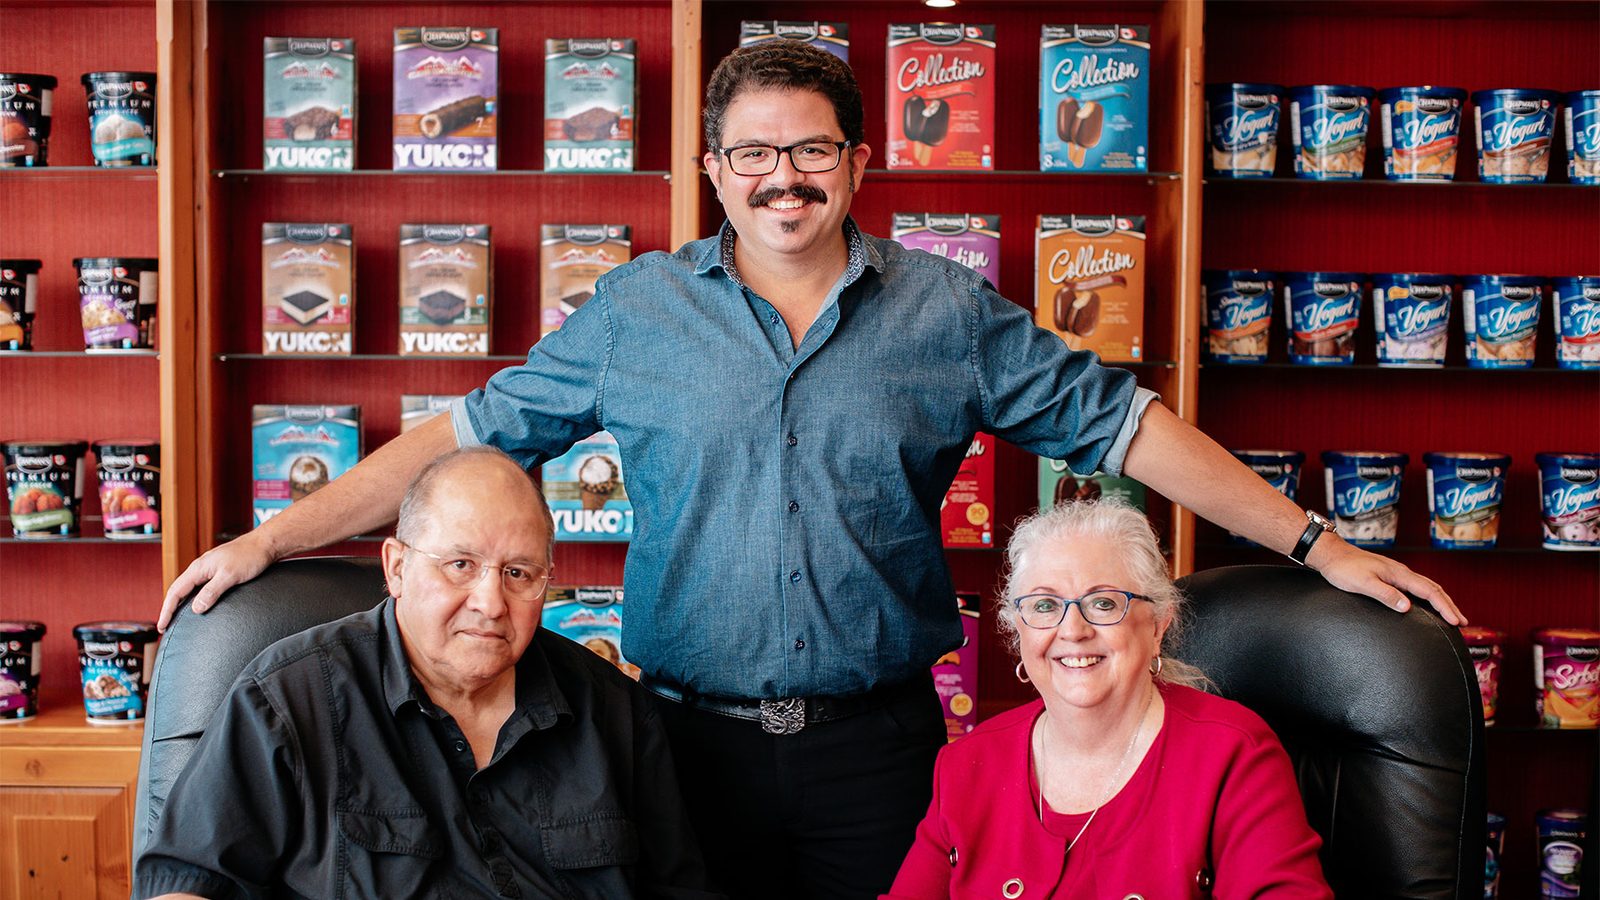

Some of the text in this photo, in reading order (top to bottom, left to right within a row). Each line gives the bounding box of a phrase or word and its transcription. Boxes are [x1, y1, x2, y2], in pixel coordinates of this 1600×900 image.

[897, 53, 985, 92] Collection
[1052, 54, 1139, 93] Collection
[1223, 110, 1274, 146] Yogurt
[1312, 112, 1364, 148] Yogurt
[1403, 115, 1455, 149] Yogurt
[1492, 116, 1545, 150] Yogurt
[266, 147, 352, 168] YUKON
[394, 144, 497, 168] YUKON
[545, 148, 633, 168] YUKON
[1049, 244, 1136, 284] Collection
[1224, 301, 1268, 331] Yogurt
[1301, 298, 1354, 333] Yogurt
[1396, 301, 1448, 336] Yogurt
[1488, 302, 1539, 336] Yogurt
[265, 332, 351, 353] YUKON
[402, 332, 488, 353] YUKON
[1345, 480, 1397, 516] Yogurt
[1444, 482, 1497, 518] Yogurt
[1553, 663, 1600, 690] Sorbe
